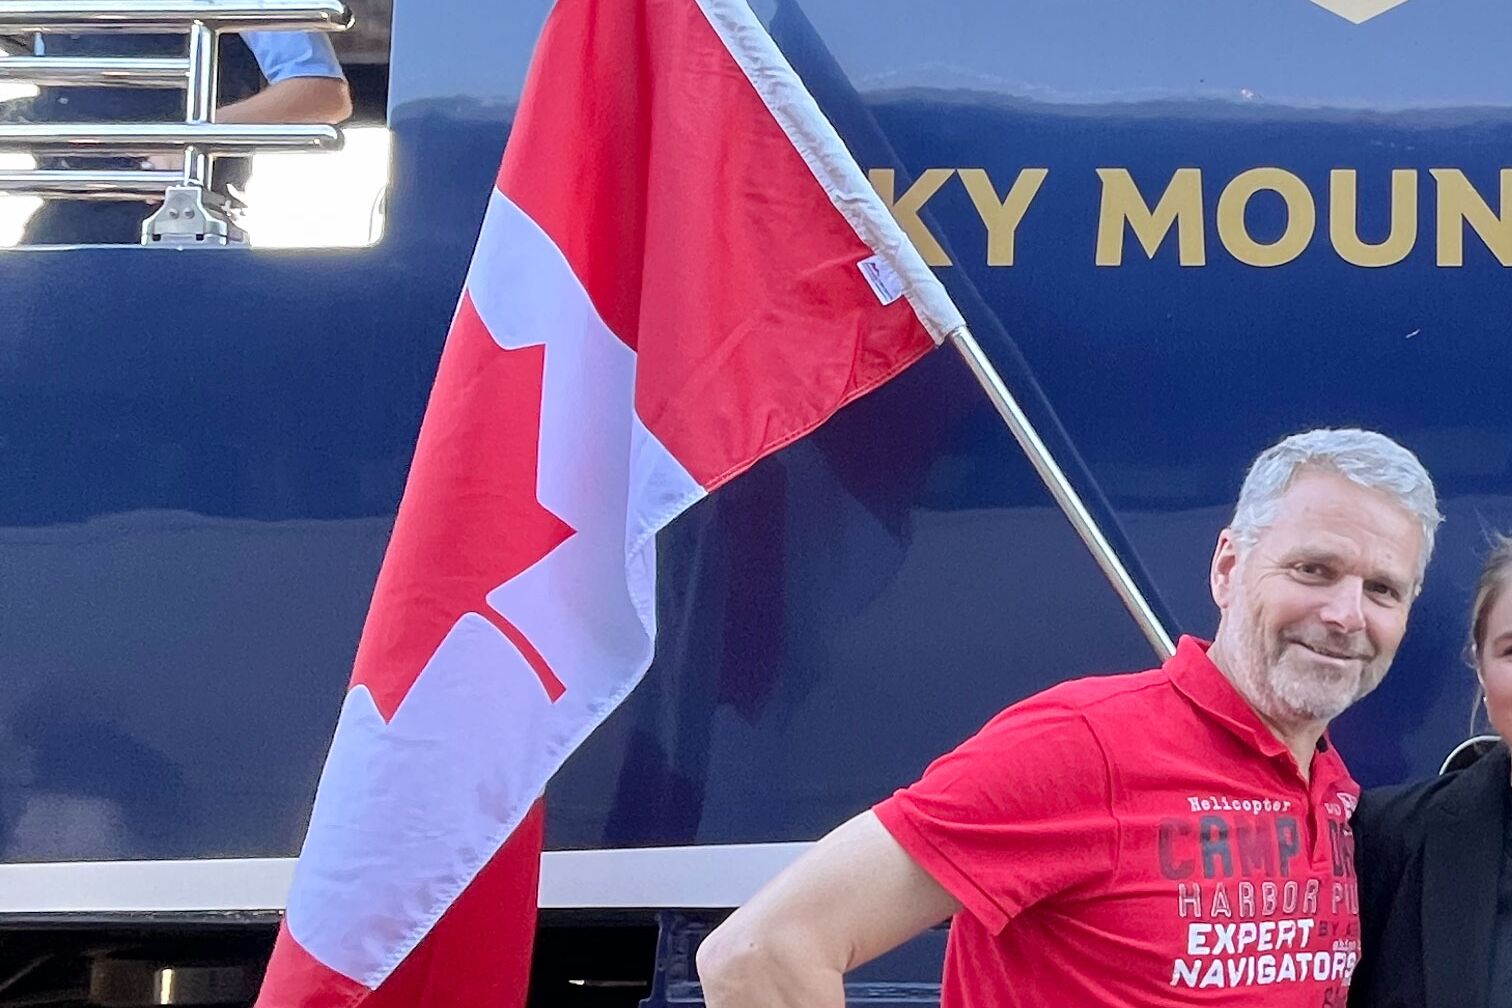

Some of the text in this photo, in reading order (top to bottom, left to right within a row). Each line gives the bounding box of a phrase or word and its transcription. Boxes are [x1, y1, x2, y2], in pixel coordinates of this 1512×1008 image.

[1187, 796, 1292, 816] Helicopter
[1157, 815, 1301, 880] CAMP
[1178, 879, 1320, 918] HARBOR
[1187, 918, 1315, 956] EXPERT
